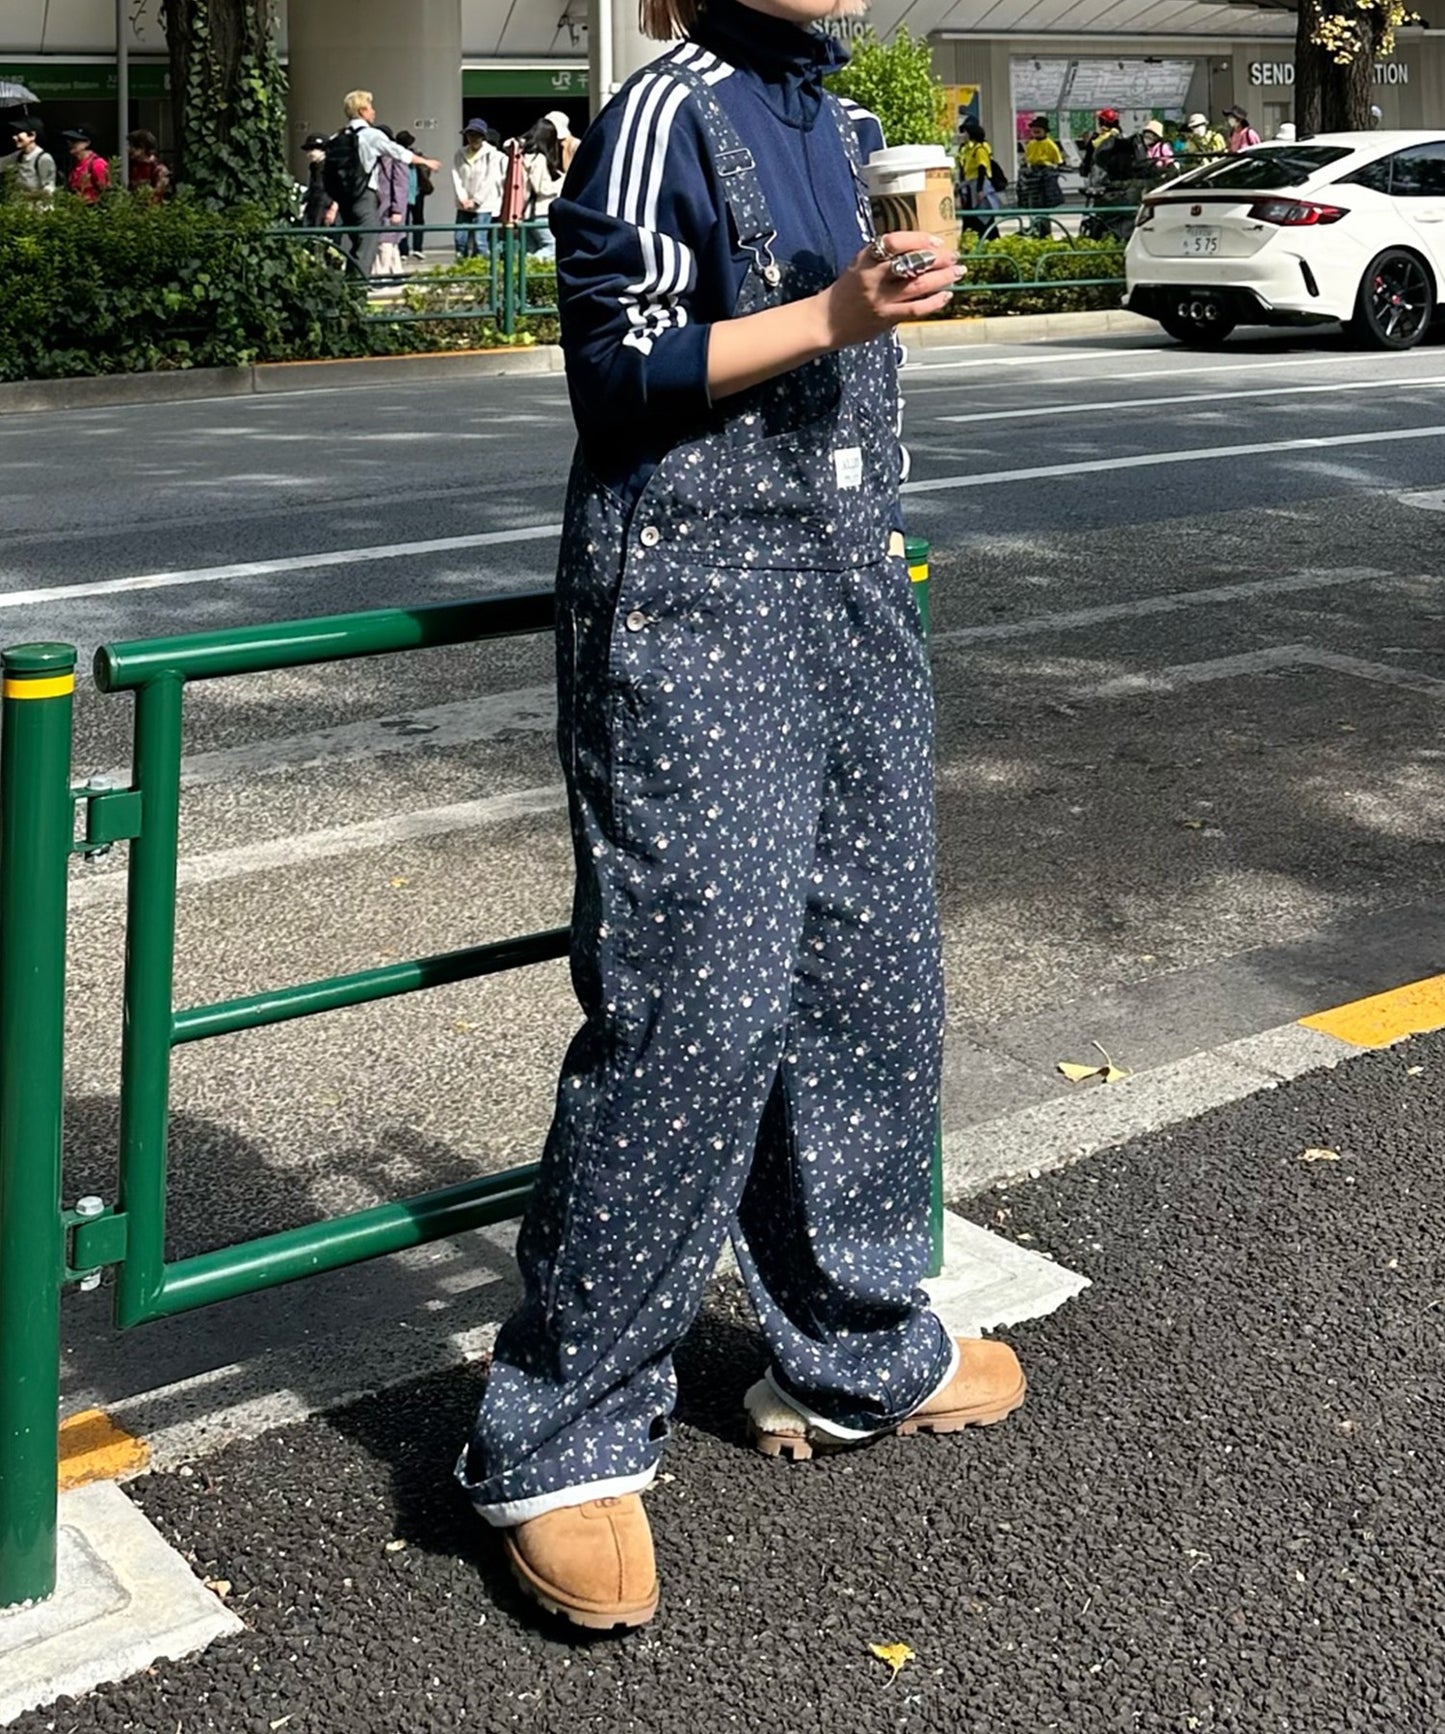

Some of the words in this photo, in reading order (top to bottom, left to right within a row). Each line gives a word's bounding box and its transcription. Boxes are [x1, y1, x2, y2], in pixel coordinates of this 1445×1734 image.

[551, 71, 571, 86] JR
[577, 72, 589, 89] 千
[1251, 63, 1295, 85] SEND
[1372, 63, 1409, 84] TION
